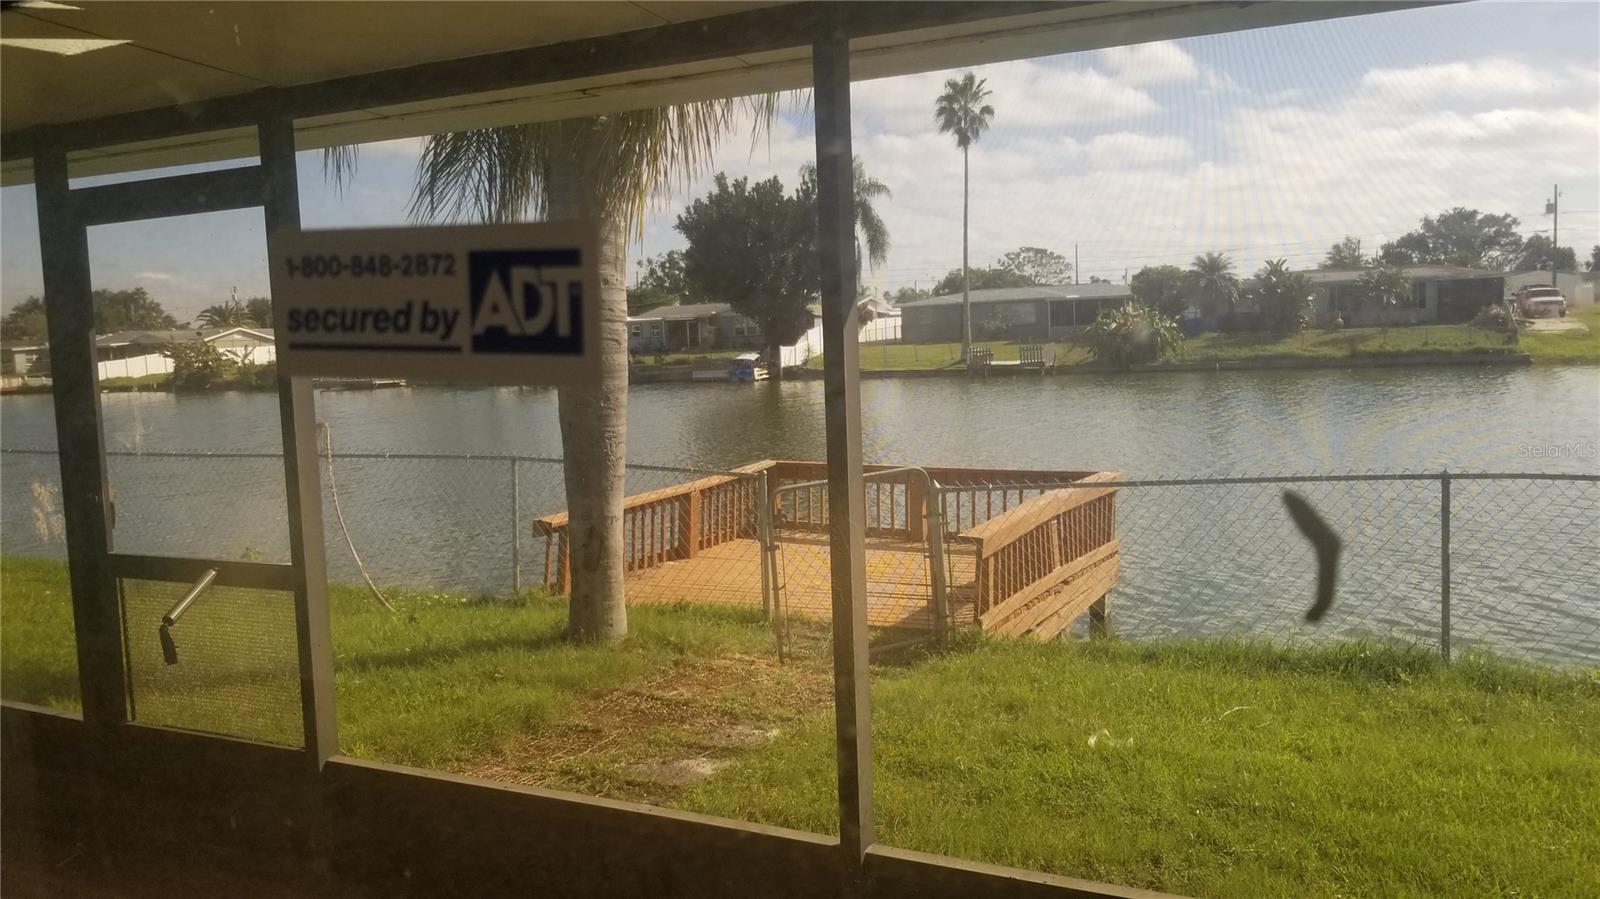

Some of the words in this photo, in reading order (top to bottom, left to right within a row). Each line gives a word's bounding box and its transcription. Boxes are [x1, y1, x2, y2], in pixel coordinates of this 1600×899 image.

[286, 253, 456, 278] 1-800-848-2872
[287, 300, 414, 335] secured
[420, 300, 460, 341] by
[472, 265, 582, 337] ADT
